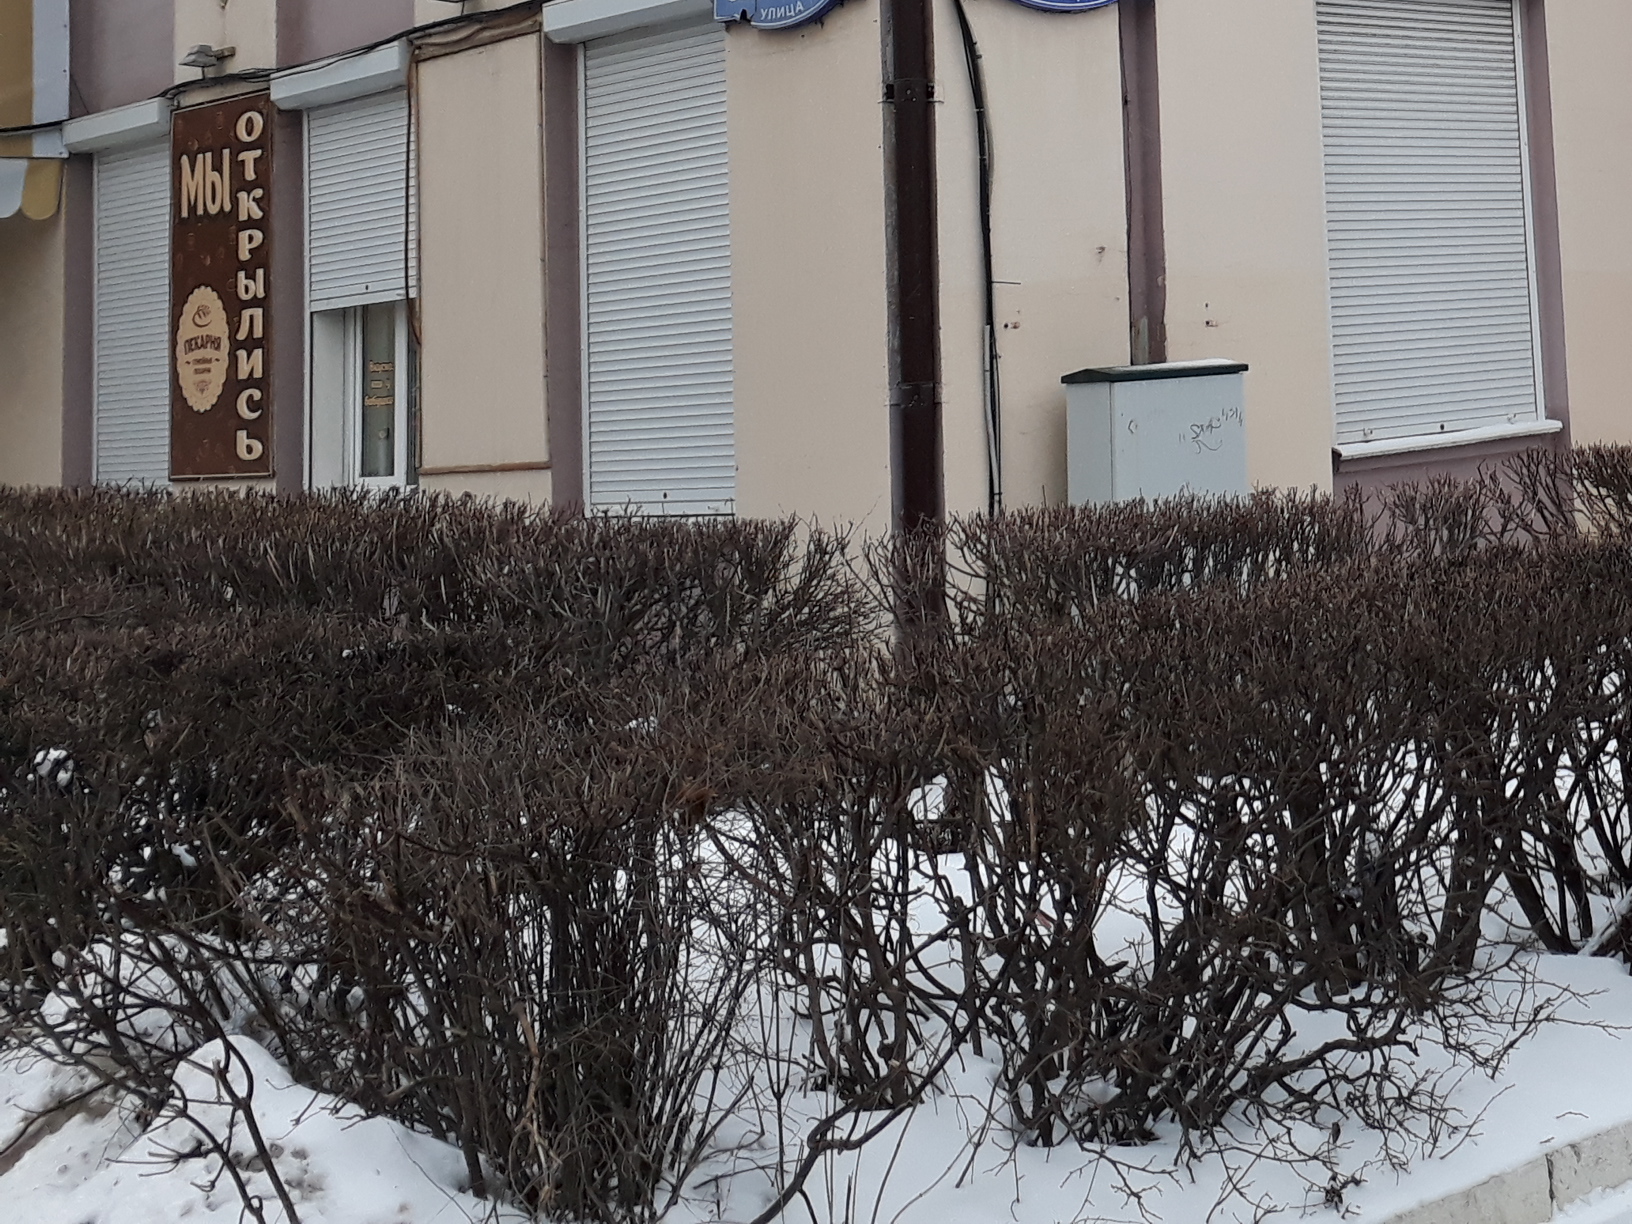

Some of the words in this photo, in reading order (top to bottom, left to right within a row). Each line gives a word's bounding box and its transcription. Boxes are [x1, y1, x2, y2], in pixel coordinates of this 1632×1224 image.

[759, 1, 804, 21] УЛИЦА
[180, 148, 232, 219] МЫ
[235, 110, 266, 461] ОТКРЫЛИСЬ
[184, 334, 221, 356] ПЕКАРНЯ
